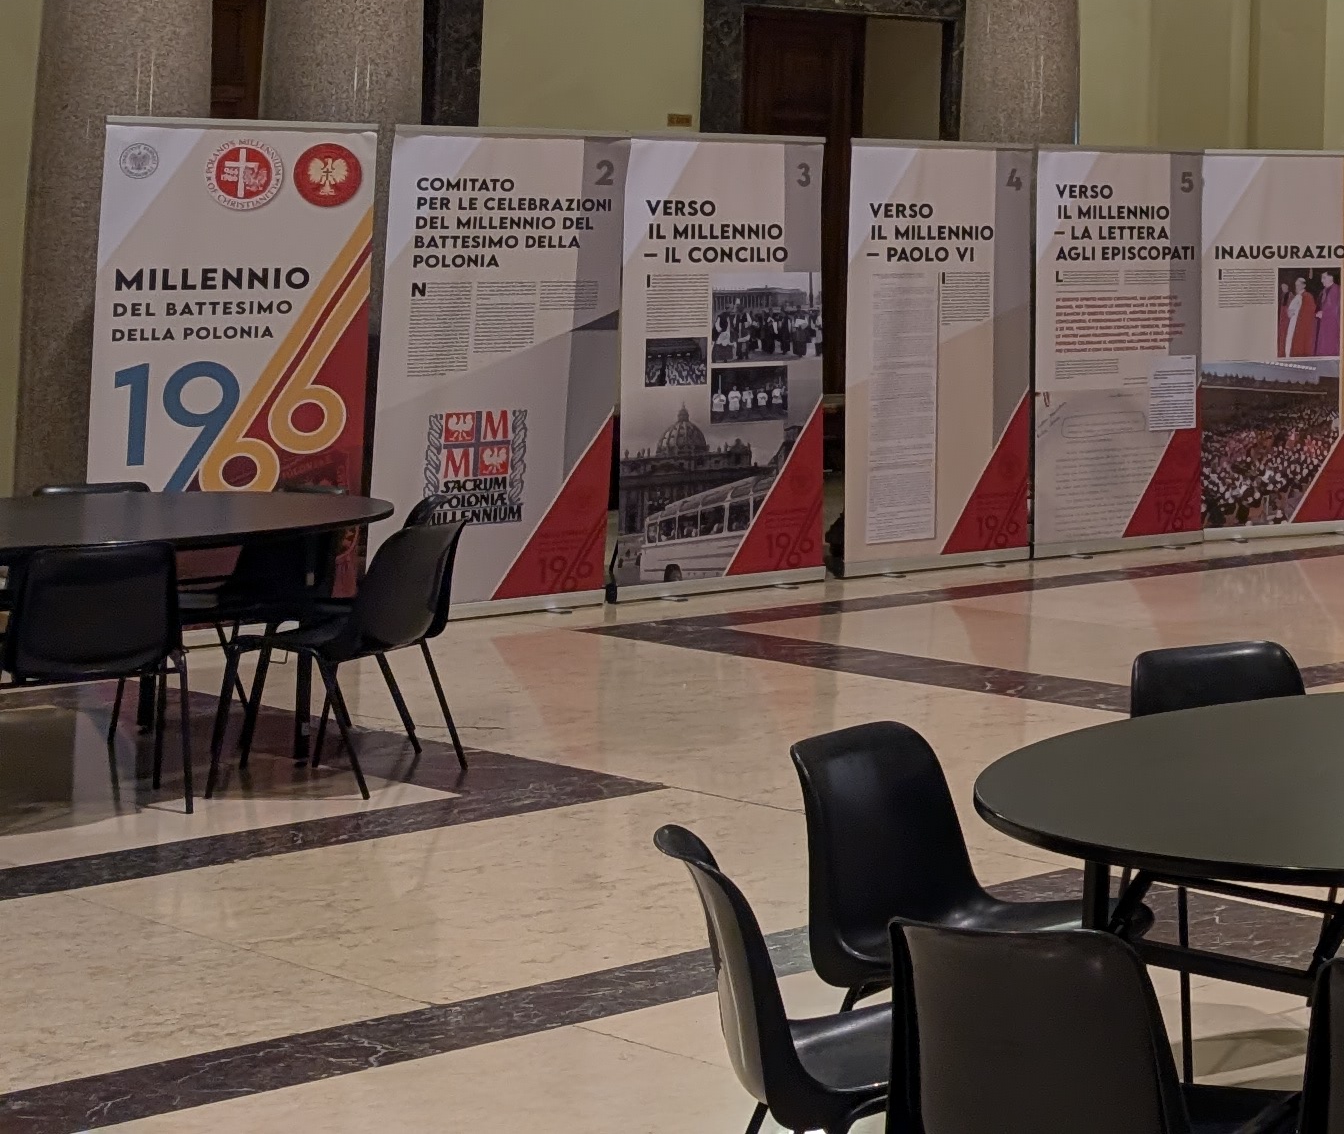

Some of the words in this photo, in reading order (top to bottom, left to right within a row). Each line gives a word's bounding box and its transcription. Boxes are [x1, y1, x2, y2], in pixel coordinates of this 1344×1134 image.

[595, 160, 615, 186] 2
[797, 163, 811, 187] 3
[1006, 169, 1022, 191] 4
[416, 177, 515, 192] COMITATO
[1181, 172, 1194, 193] 5
[1056, 184, 1113, 199] VERSO
[417, 197, 451, 211] PER
[458, 197, 478, 211] LE
[483, 197, 612, 212] CELEBRAZIONI
[646, 200, 716, 216] VERSO
[869, 203, 933, 218] VERSO
[1058, 205, 1072, 219] IL
[1078, 205, 1169, 219] MILLENNIO
[415, 216, 449, 230] DEL
[456, 216, 556, 230] MILLENNIO
[562, 217, 594, 230] DEL
[649, 224, 666, 239] IL
[673, 224, 782, 239] MILLENNIO
[871, 225, 887, 240] IL
[895, 226, 993, 240] MILLENNIO
[1071, 226, 1092, 240] LA
[1099, 226, 1169, 240] LETTERA
[414, 235, 519, 249] BATTESIMO
[525, 235, 581, 249] DELLA
[412, 254, 500, 268] POLONIA
[665, 247, 681, 263] IL
[688, 247, 788, 262] CONCILIO
[887, 247, 949, 262] PAOLO
[956, 247, 974, 262] VI
[1056, 246, 1095, 261] AGLI
[1101, 246, 1194, 261] EPISCOPATI
[115, 267, 310, 291] MILLENNIO
[1055, 271, 1063, 283] L
[411, 282, 427, 297] N
[113, 302, 156, 317] DEL
[165, 300, 292, 316] BATTESIMO
[112, 328, 175, 342] DELLA
[183, 326, 274, 340] POLONIA
[483, 410, 509, 440] M
[444, 448, 470, 479] M
[441, 477, 507, 494] SACRUM
